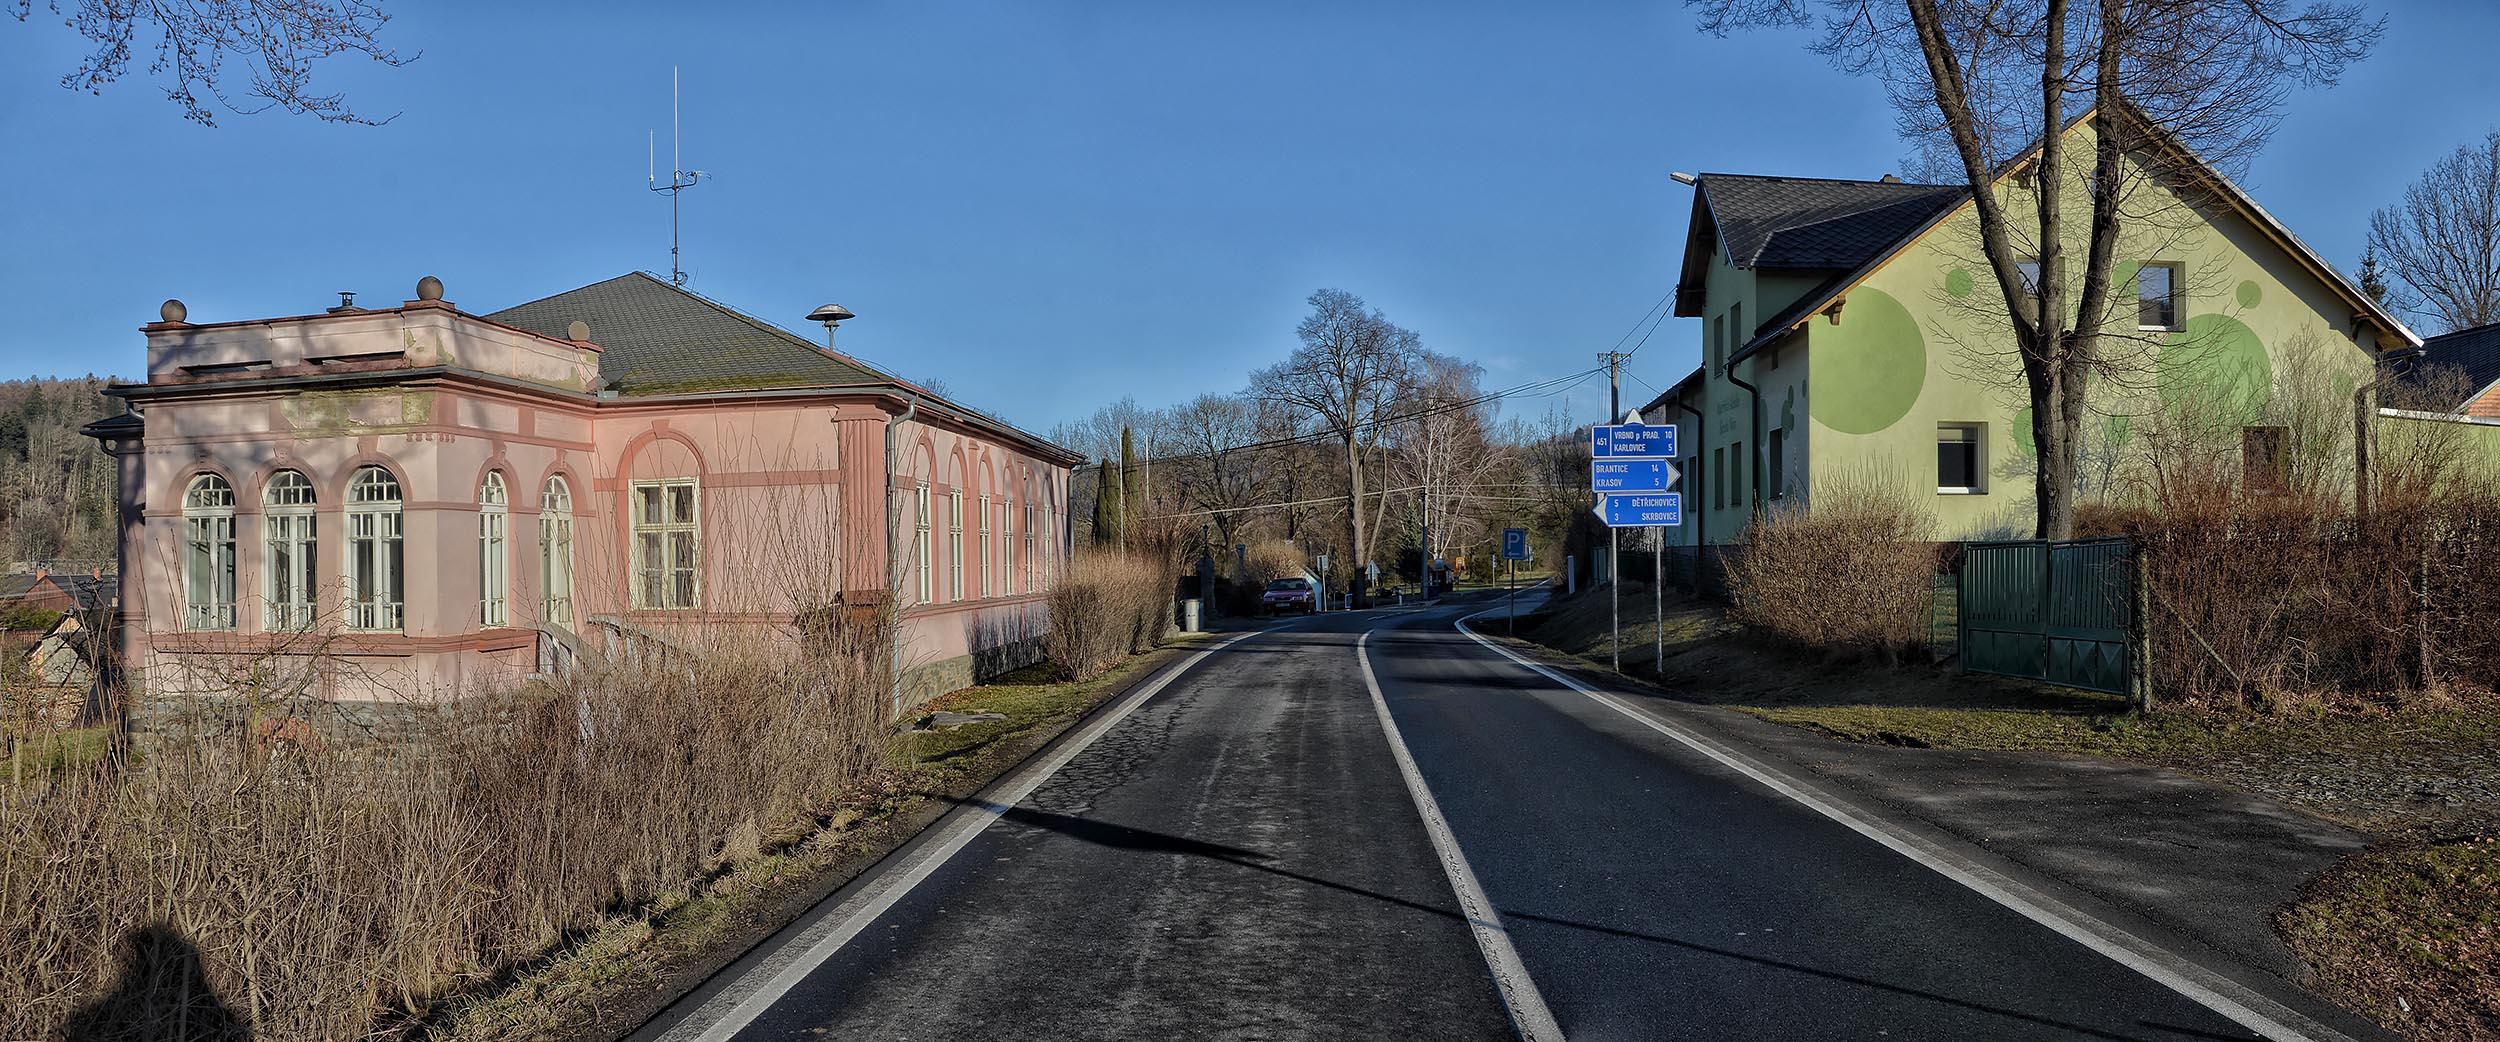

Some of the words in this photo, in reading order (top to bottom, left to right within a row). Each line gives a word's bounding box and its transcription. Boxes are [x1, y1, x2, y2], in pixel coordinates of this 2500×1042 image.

[1614, 431, 1634, 440] VRBNO
[1665, 431, 1672, 439] 10
[1596, 438, 1607, 446] 451
[1614, 443, 1646, 452] KARLOVICE
[1668, 443, 1673, 452] 5
[1596, 464, 1629, 473] BRANTICE
[1651, 464, 1659, 472] 14
[1596, 478, 1622, 487] KRASOV
[1654, 478, 1659, 486] 5
[1614, 499, 1619, 507] 5
[1632, 497, 1677, 507] DĚTŘICHOVICE
[1614, 513, 1619, 521] 3
[1641, 512, 1677, 521] SKRBOVICE
[1508, 532, 1521, 549] P
